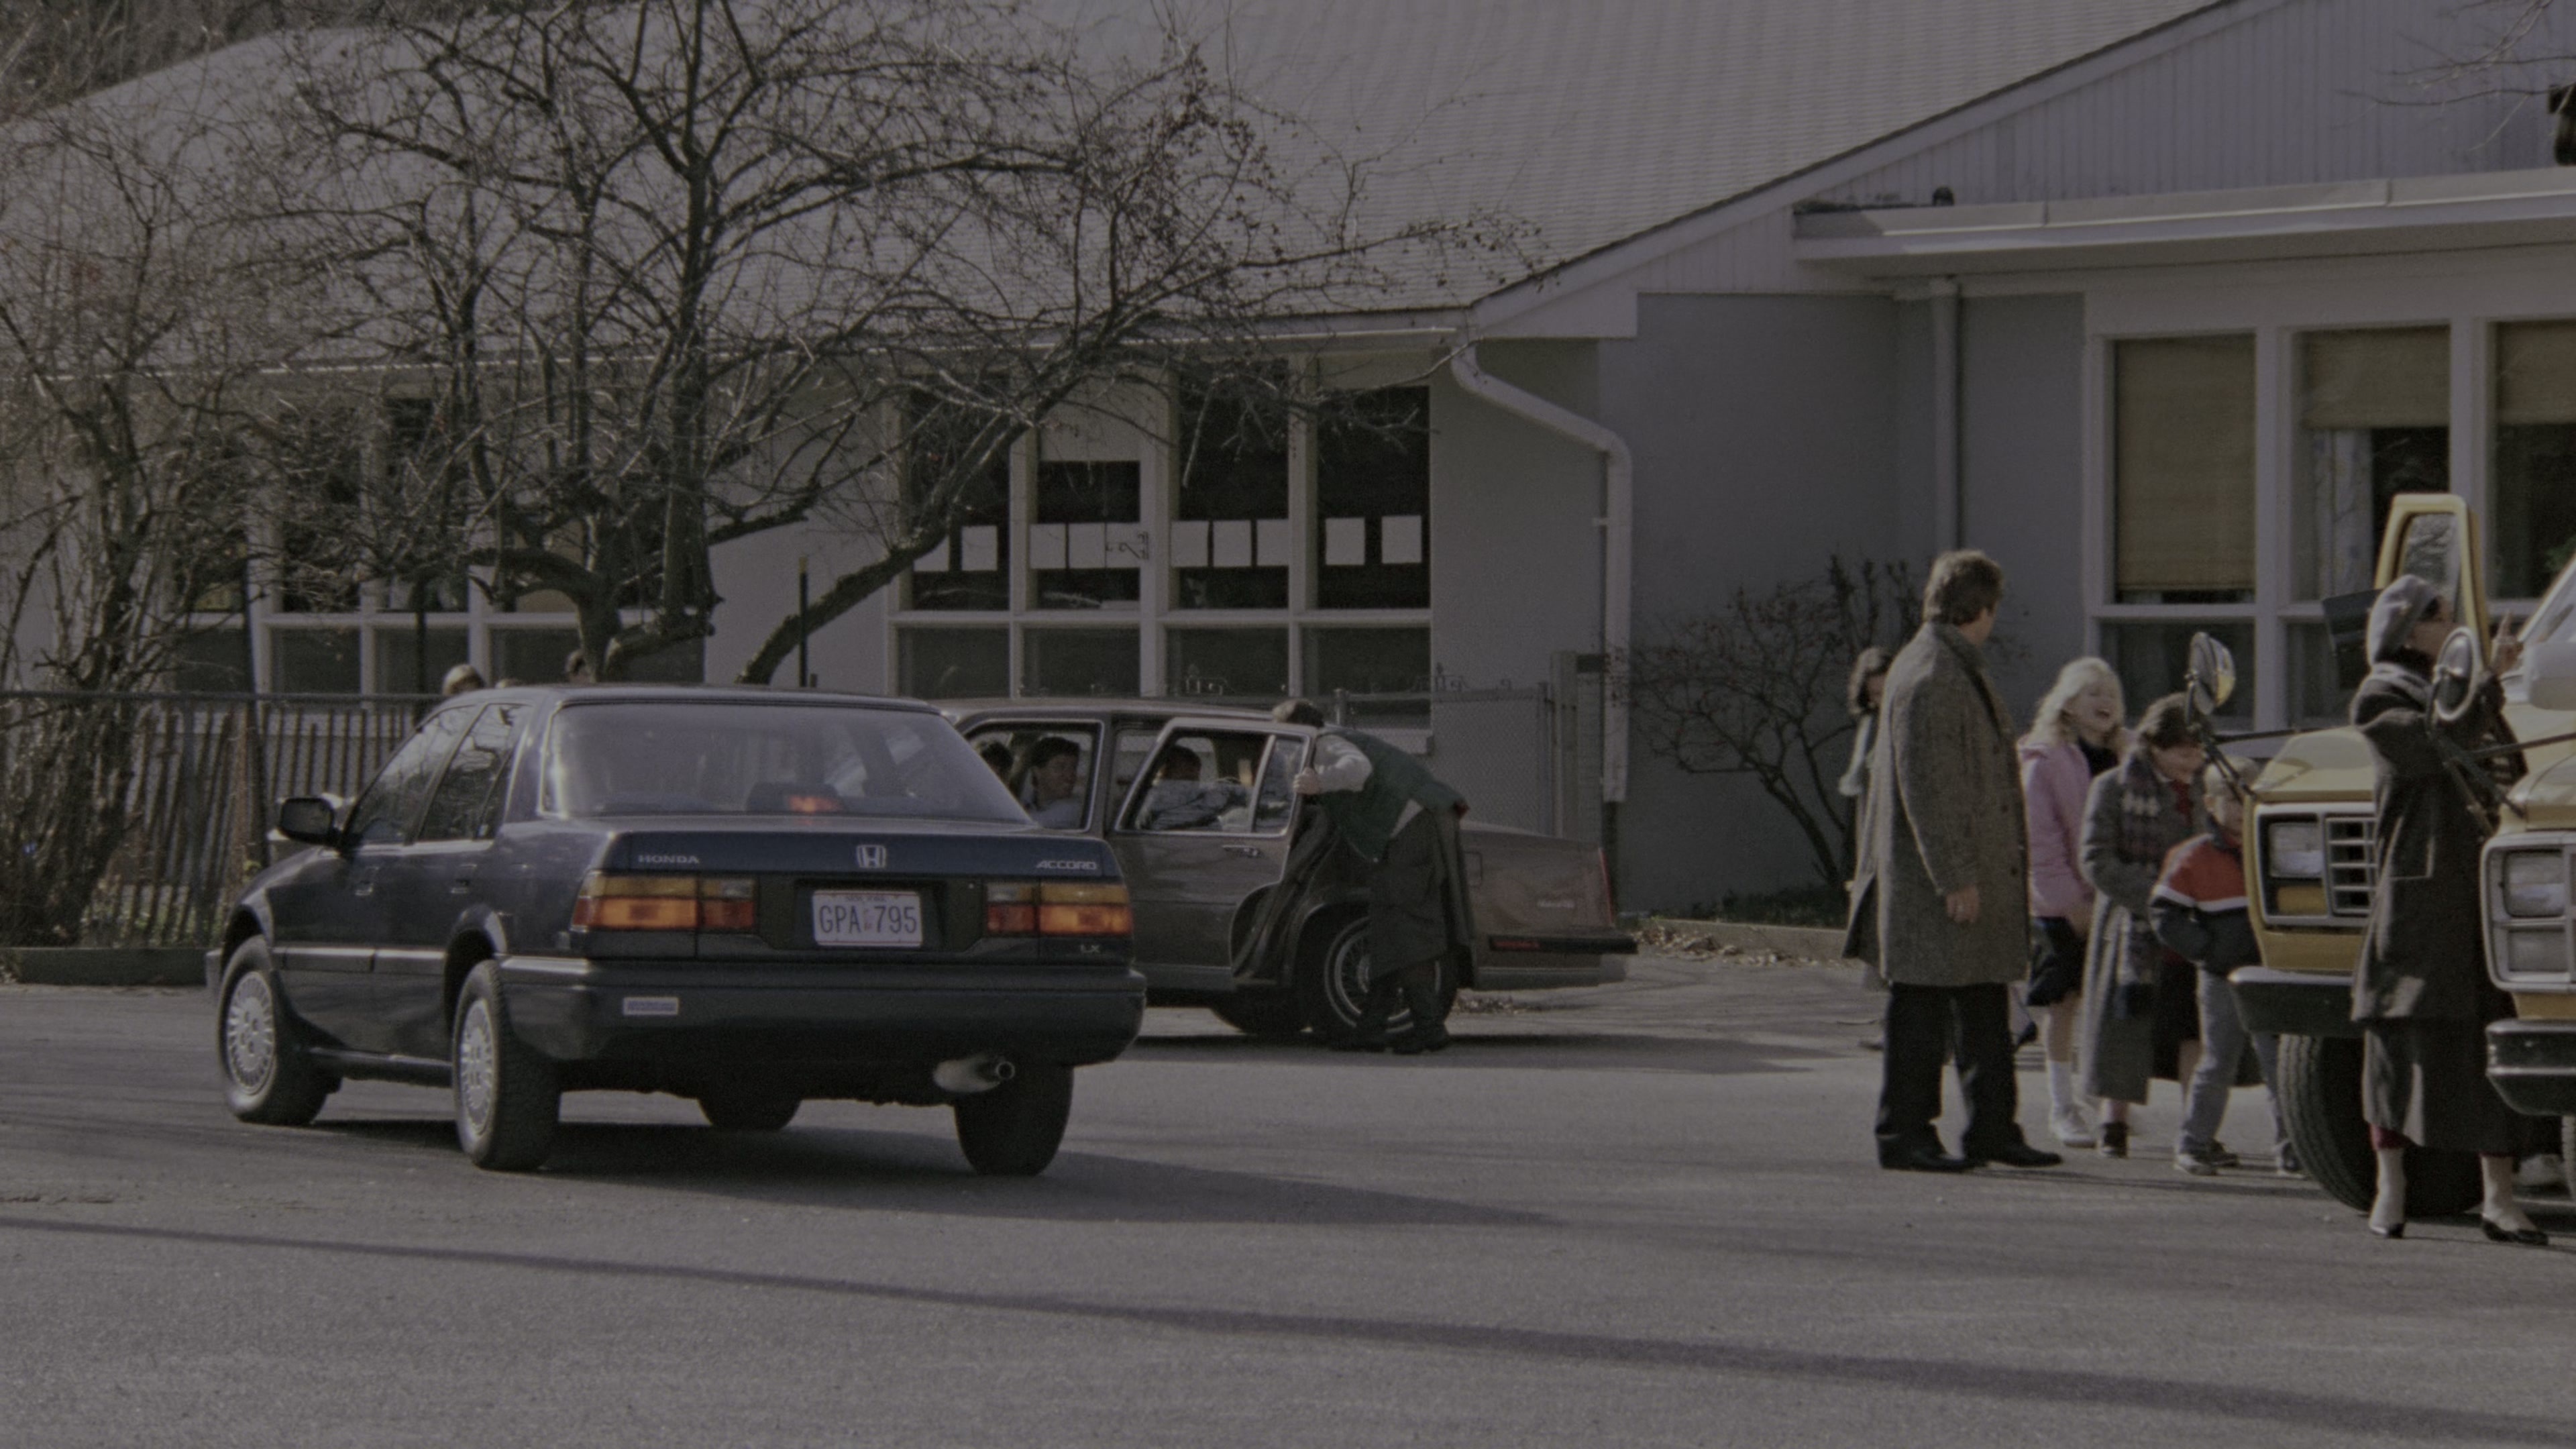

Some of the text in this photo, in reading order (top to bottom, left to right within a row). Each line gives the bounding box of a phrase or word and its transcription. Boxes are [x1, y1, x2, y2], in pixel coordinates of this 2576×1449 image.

[638, 855, 700, 864] HONDA
[1036, 860, 1097, 870] ACCORD
[819, 905, 917, 934] GPA 795
